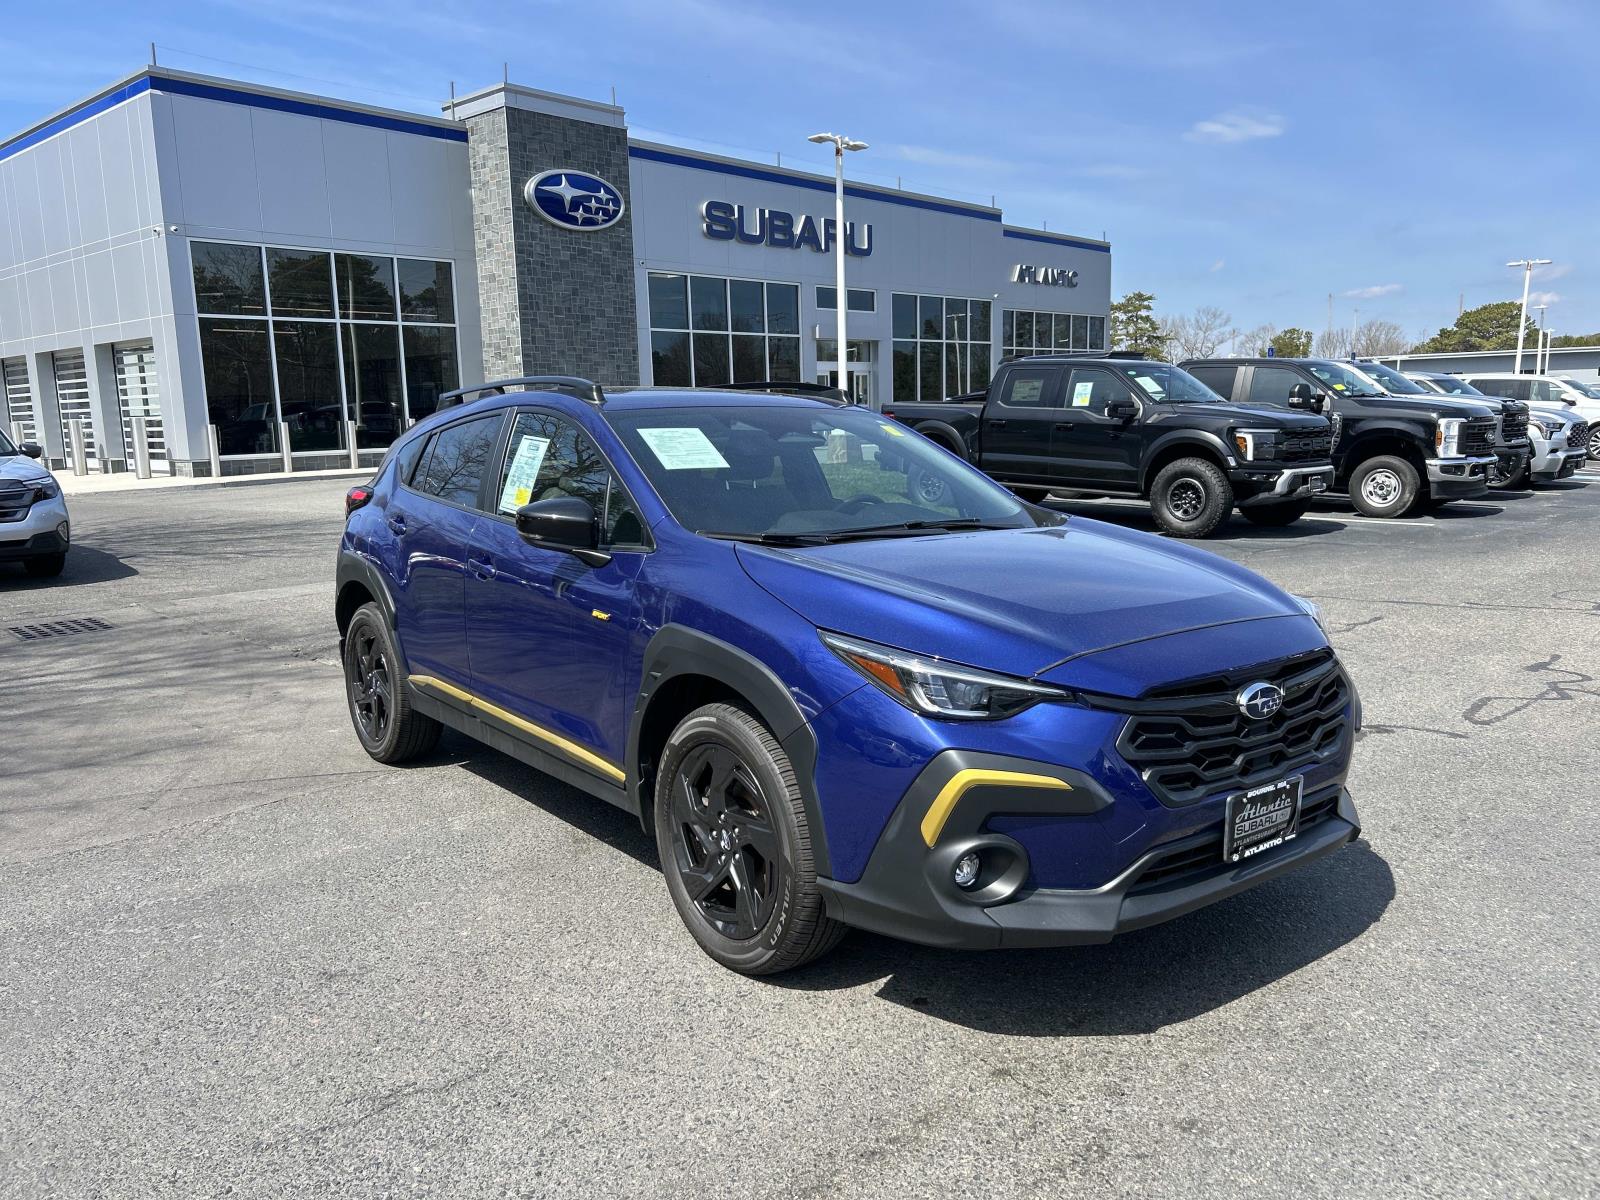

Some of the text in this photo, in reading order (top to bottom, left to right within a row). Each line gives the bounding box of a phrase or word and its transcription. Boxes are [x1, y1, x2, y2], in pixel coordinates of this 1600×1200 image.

[702, 200, 873, 256] SUBARU
[1010, 264, 1078, 288] ATLANTIC
[1235, 794, 1292, 823] Atlantic
[1236, 814, 1278, 835] SUBARU
[1244, 837, 1283, 857] ATLANTIC
